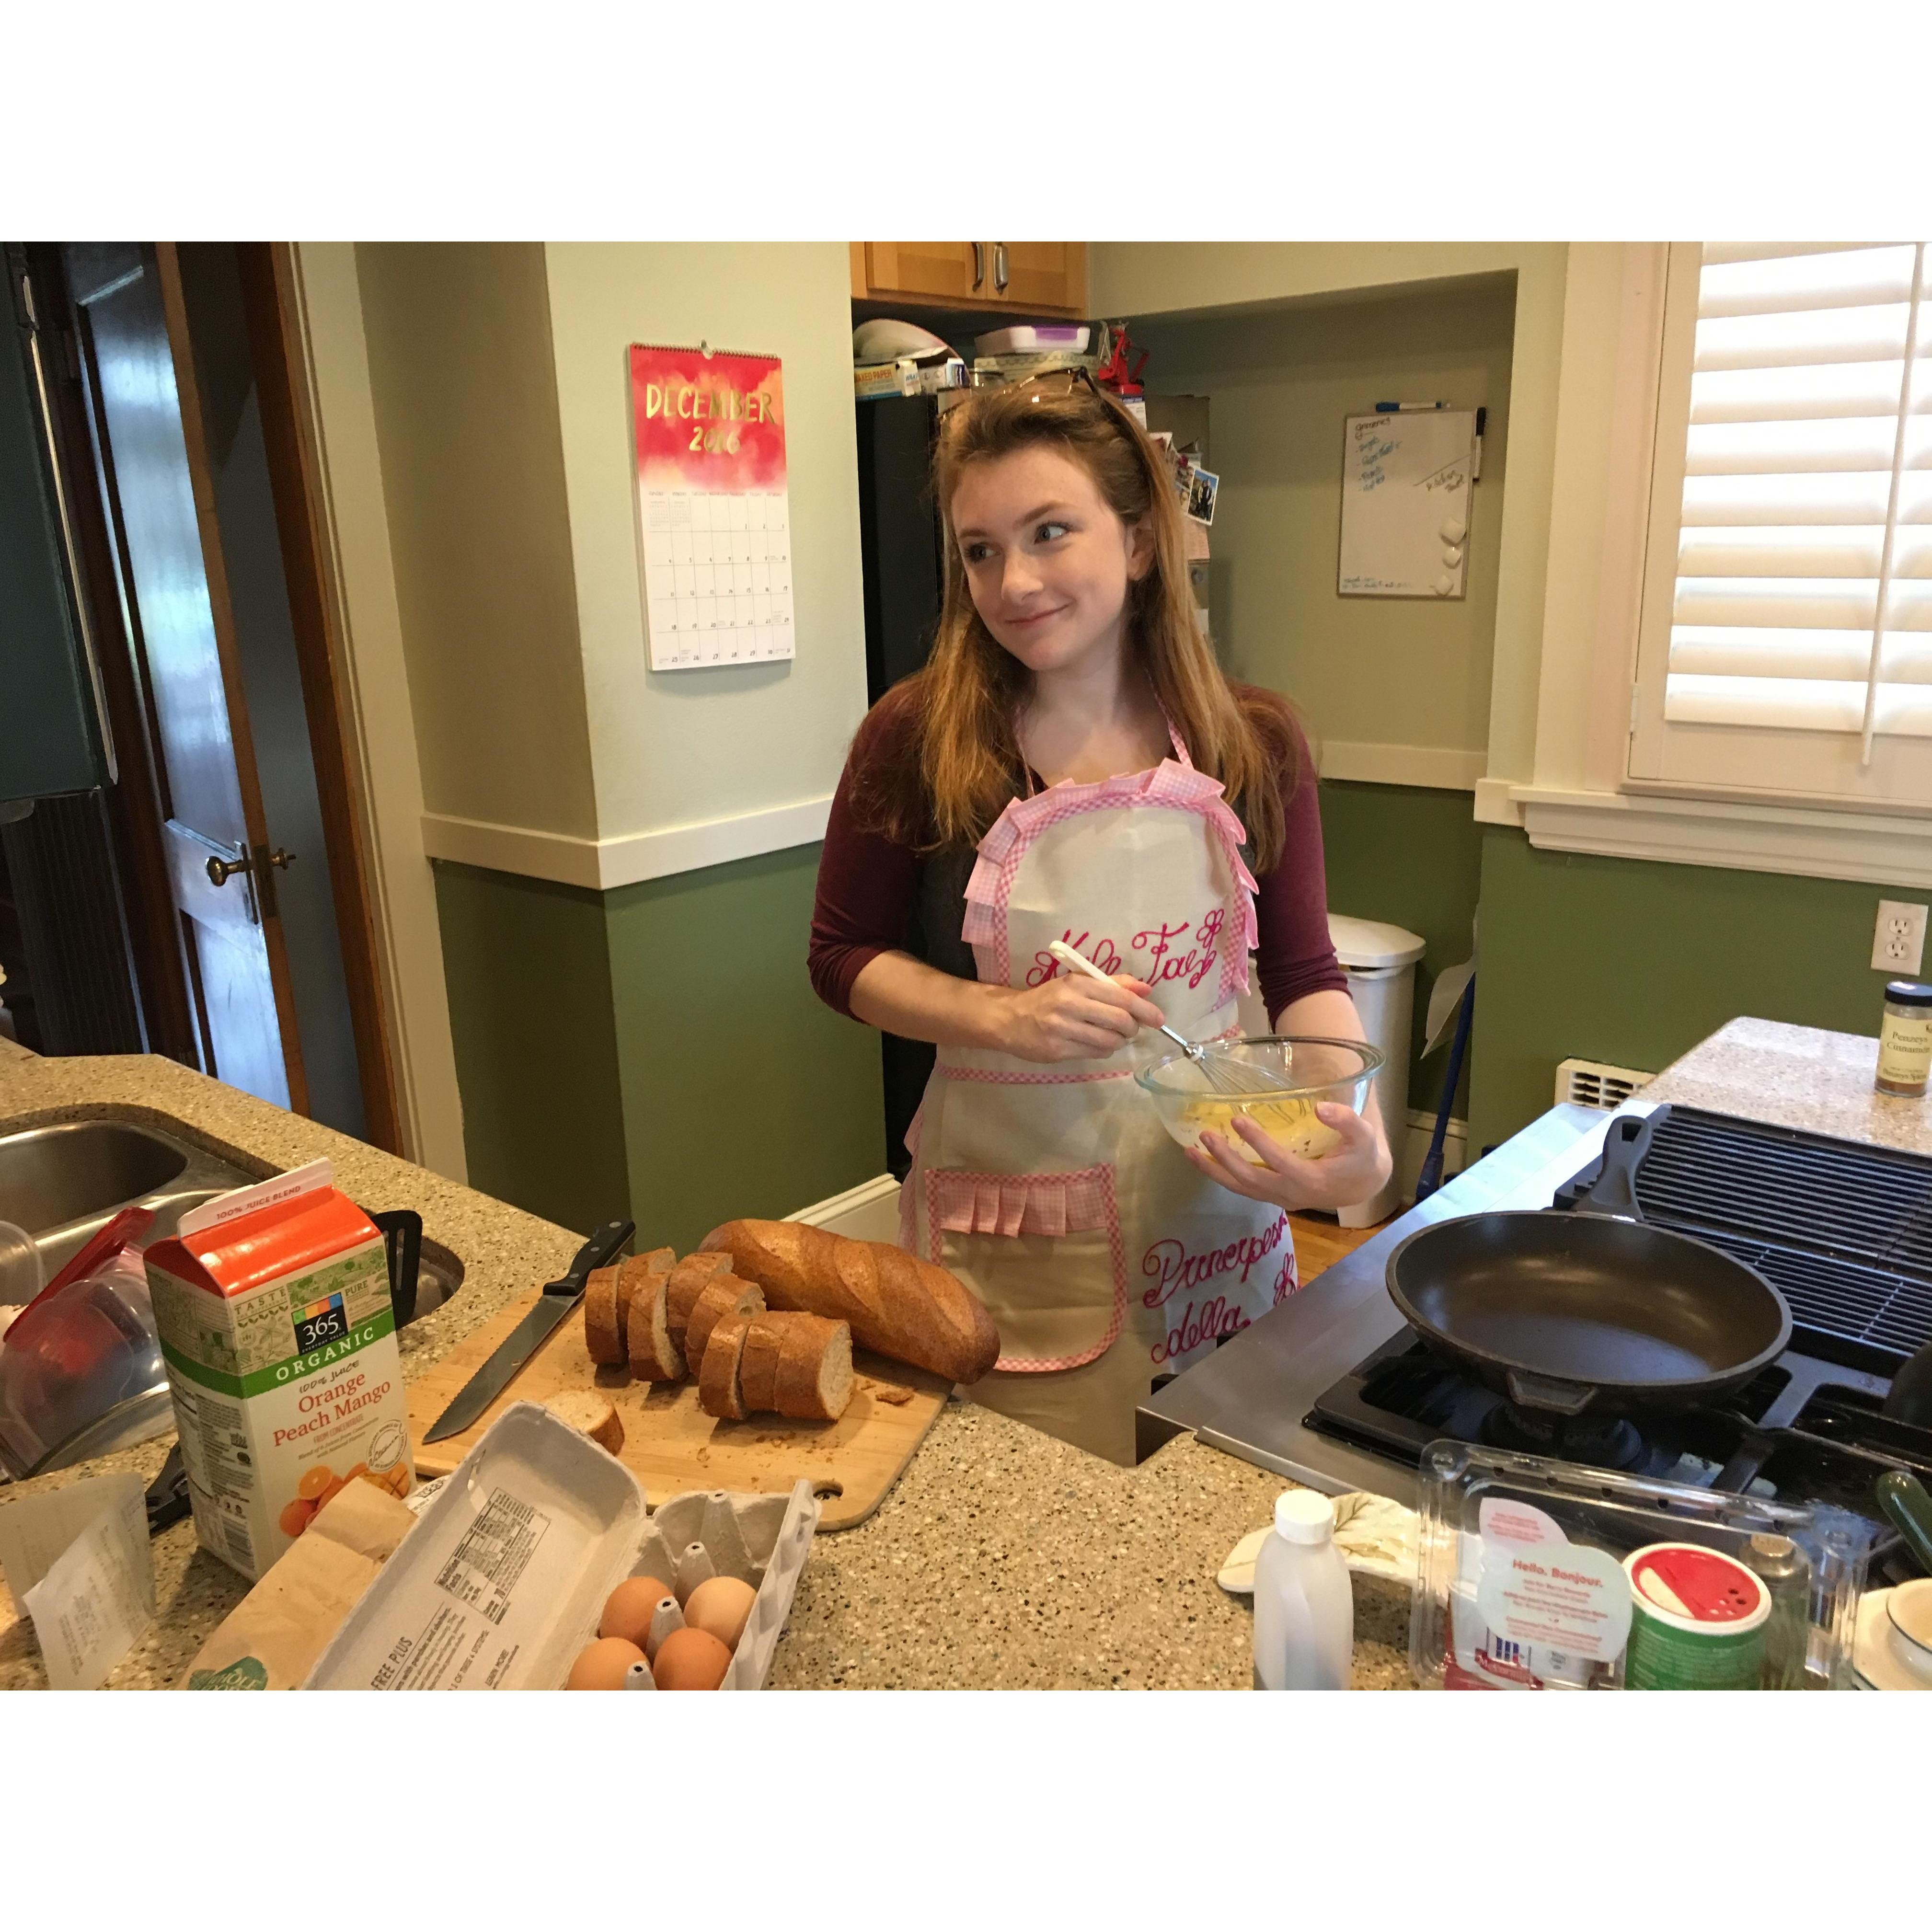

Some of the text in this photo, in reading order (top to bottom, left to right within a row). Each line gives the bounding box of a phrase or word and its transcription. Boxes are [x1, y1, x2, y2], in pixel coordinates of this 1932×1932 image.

[873, 368, 892, 380] PAPER
[646, 384, 774, 424] DECEMBER
[689, 426, 740, 455] 2016
[217, 1185, 301, 1219] 100% JUICE BLEND
[234, 1288, 287, 1315] TASTE
[345, 1280, 368, 1297] PURE
[302, 1331, 346, 1354] EVERYDAY VALUE
[303, 1313, 339, 1346] 365
[276, 1327, 374, 1380] ORGANIC
[299, 1360, 360, 1393] 100% JUICE
[299, 1373, 366, 1413] Orange
[273, 1411, 331, 1447] Peach
[334, 1380, 391, 1421] Mango
[329, 1413, 364, 1437] CONCENTRATE
[1513, 1559, 1603, 1588] Hello. Bonjour.
[389, 1636, 413, 1664] PLUS
